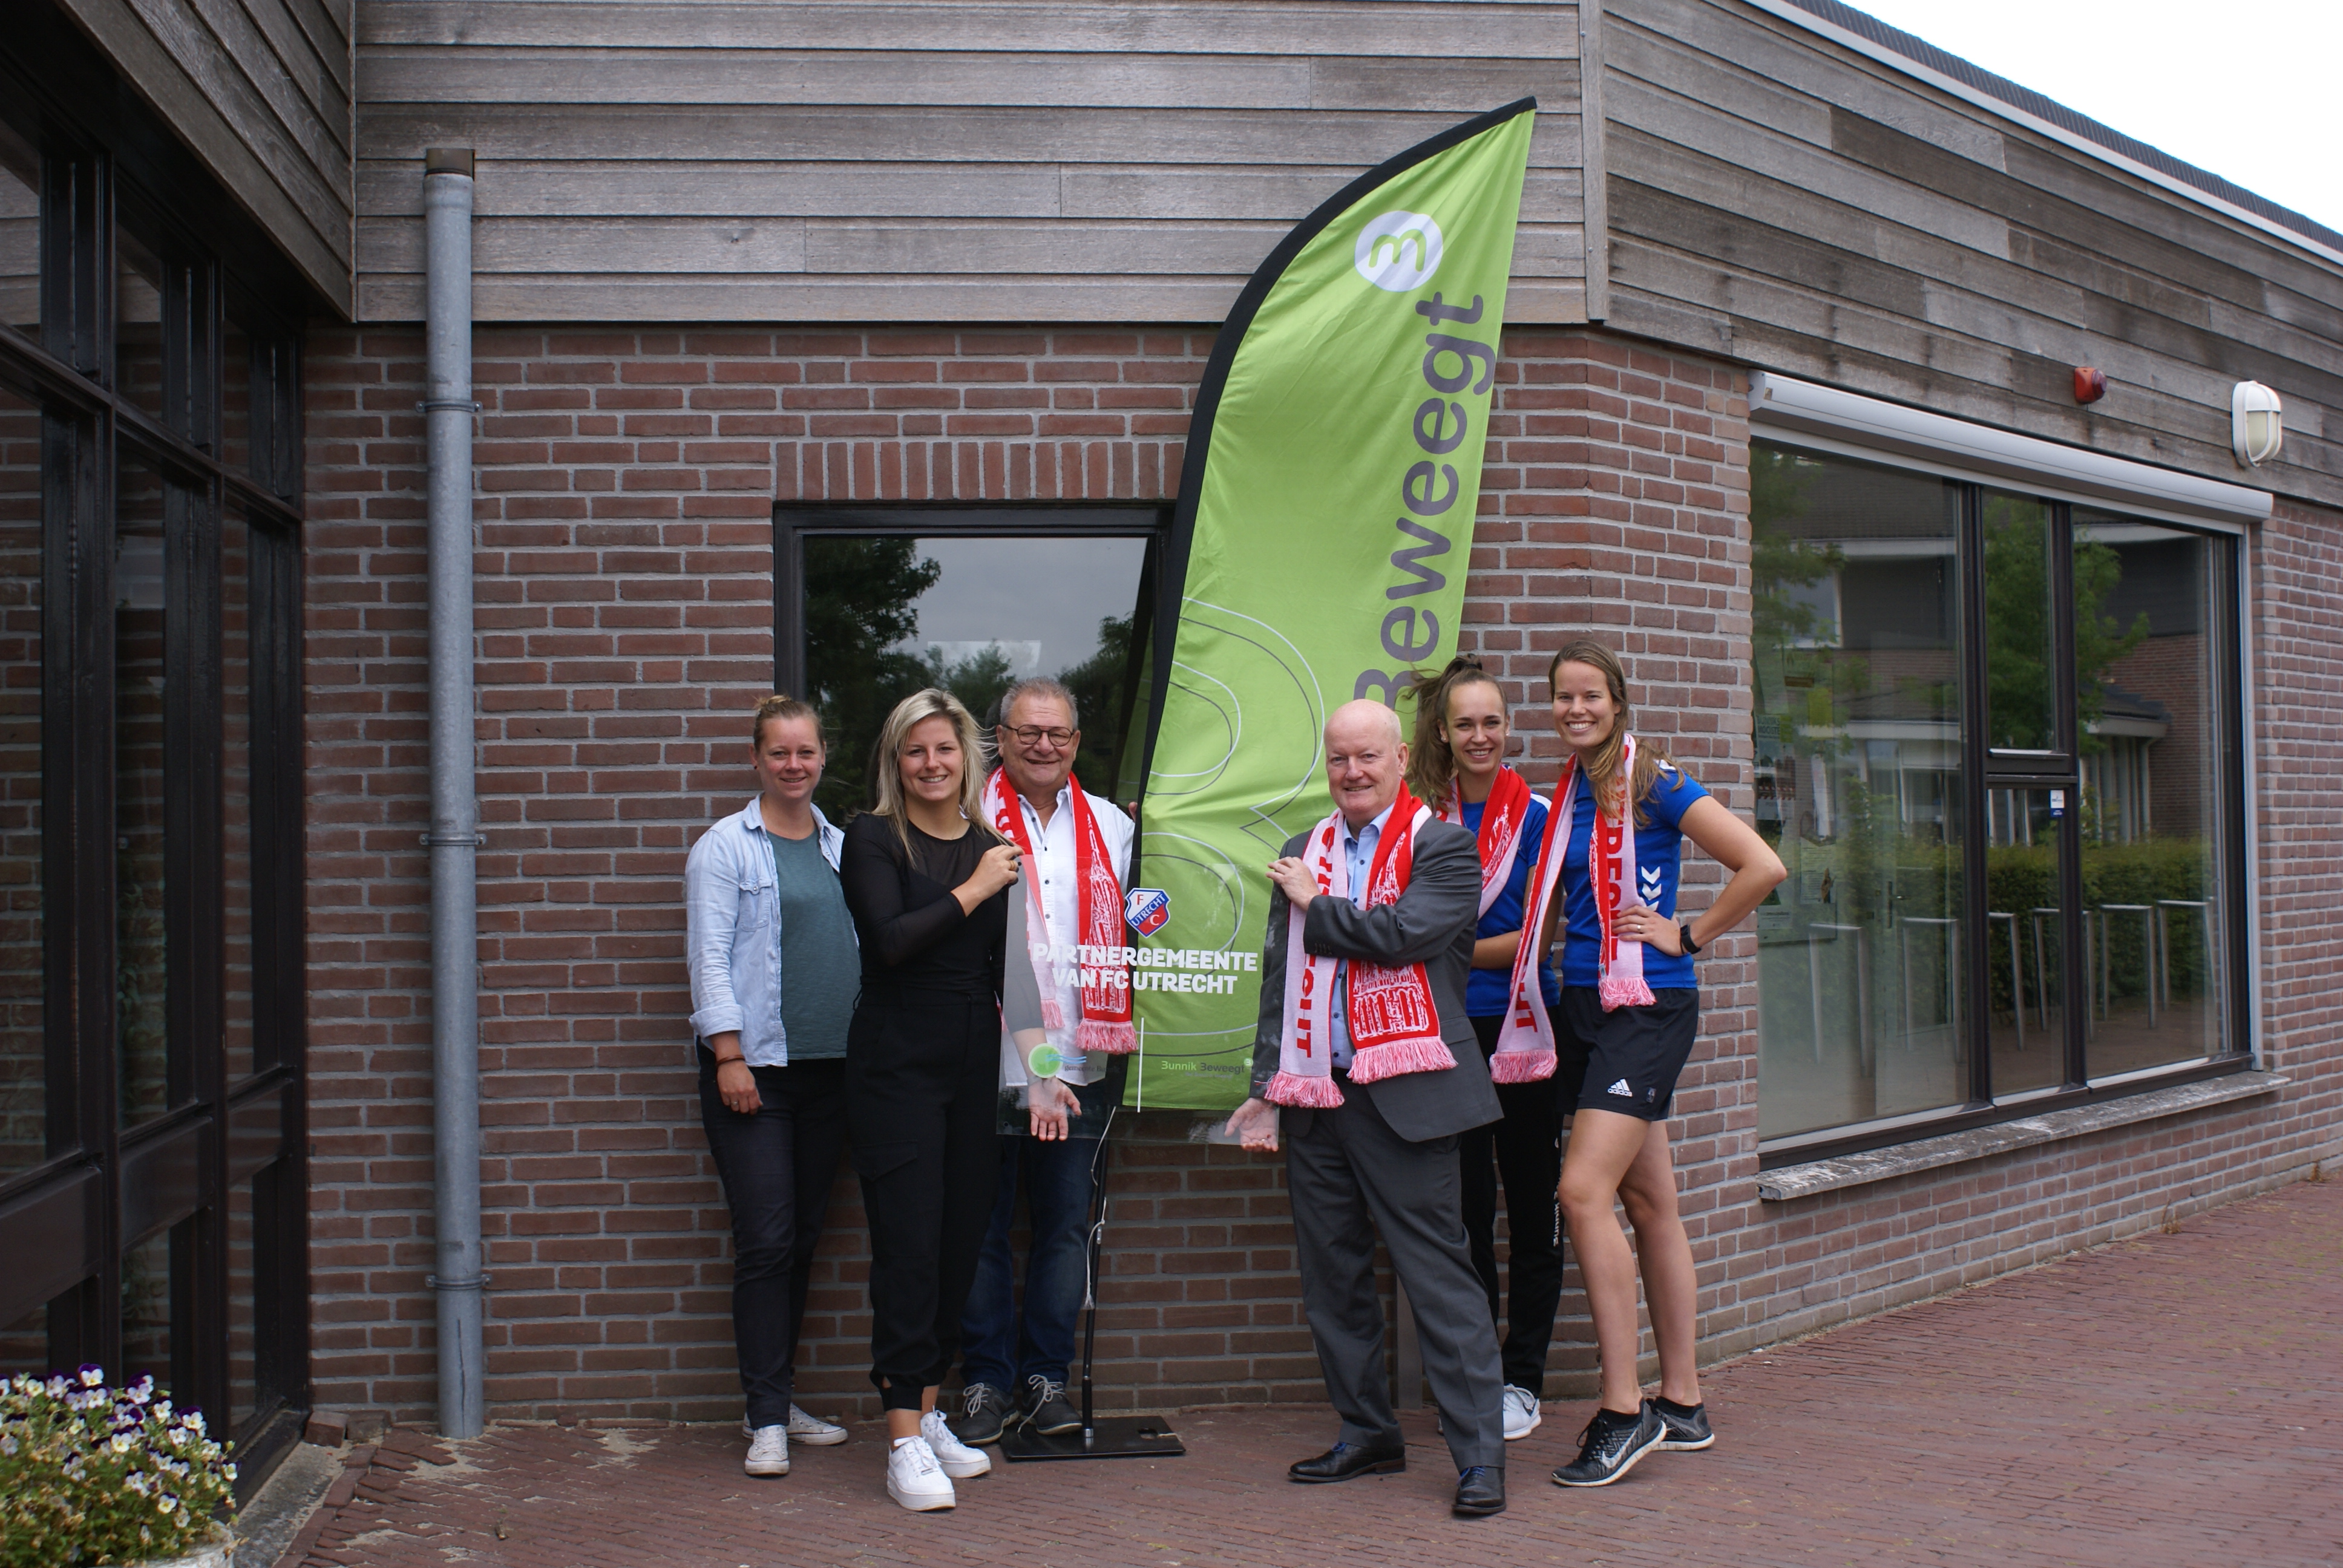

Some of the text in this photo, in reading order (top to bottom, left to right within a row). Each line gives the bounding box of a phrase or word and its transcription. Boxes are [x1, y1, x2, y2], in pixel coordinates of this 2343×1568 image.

[1354, 292, 1496, 714] Beweegt
[1131, 893, 1165, 926] UTRECHT
[1136, 894, 1144, 906] F
[1150, 914, 1160, 926] C
[1033, 942, 1258, 972] PARTNERGEMEENTE
[1053, 968, 1238, 995] VAN FC UTRECHT
[1607, 1088, 1633, 1097] adidas
